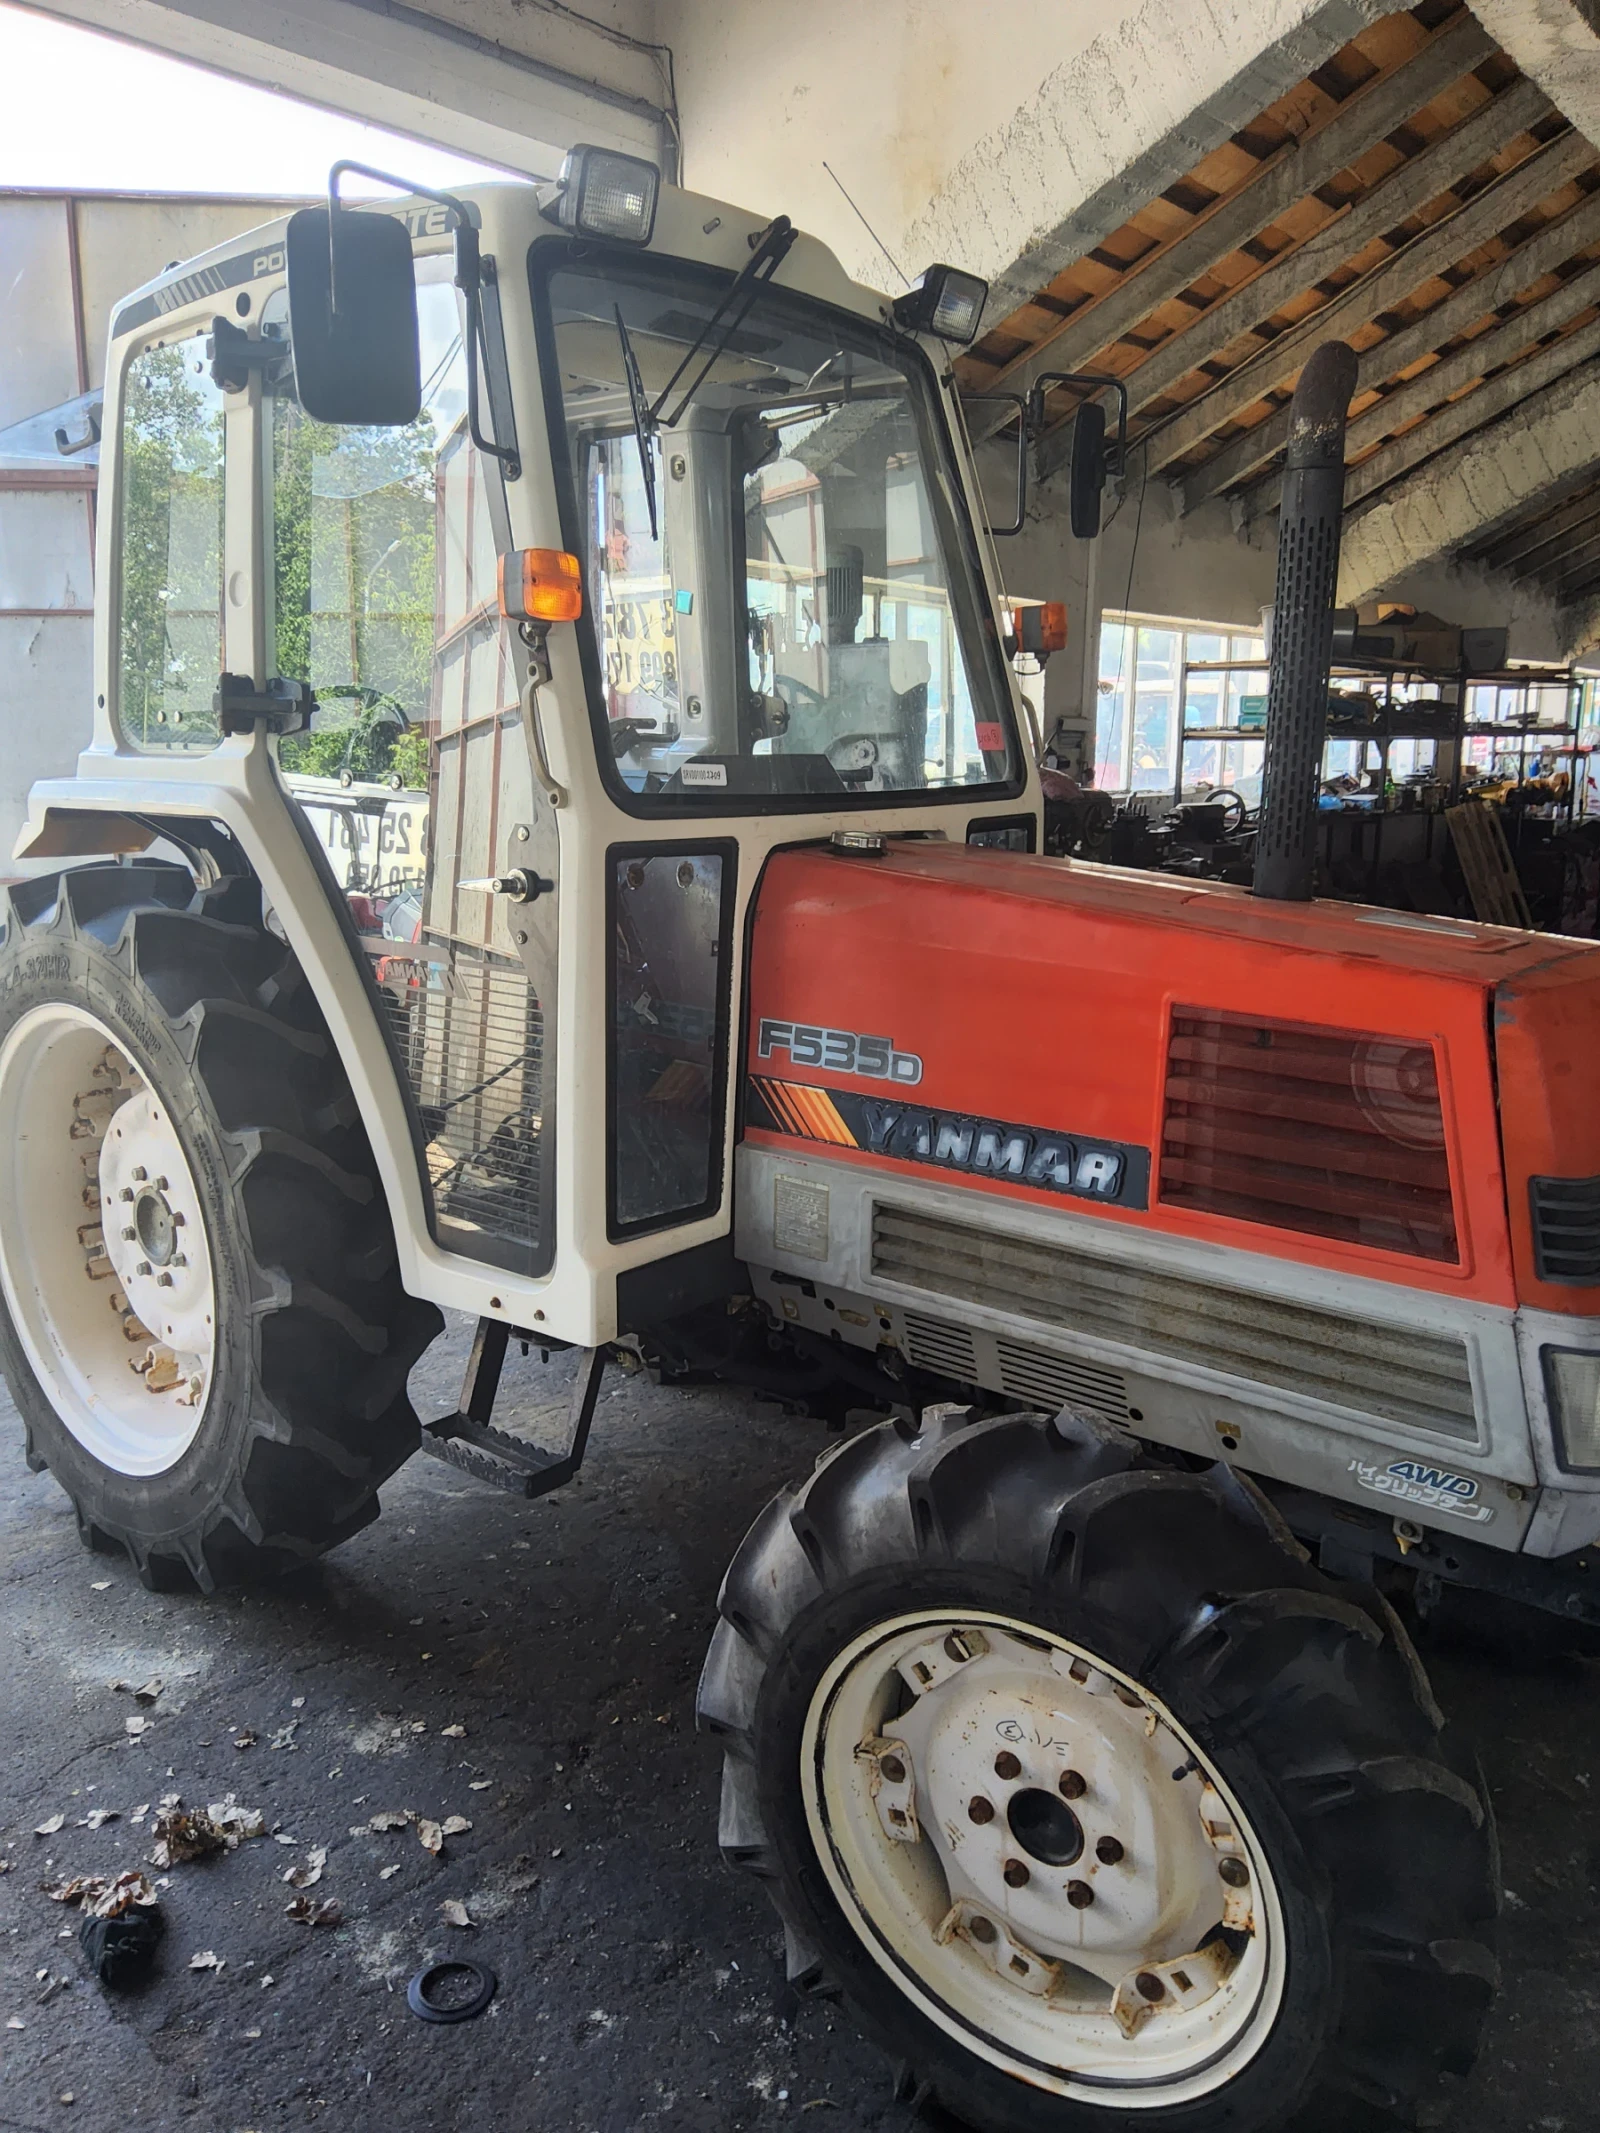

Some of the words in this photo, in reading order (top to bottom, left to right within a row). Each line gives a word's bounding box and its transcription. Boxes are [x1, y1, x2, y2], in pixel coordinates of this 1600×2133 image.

[758, 1018, 923, 1085] F535D
[863, 1104, 1125, 1196] YANMAR
[1387, 1461, 1478, 1499] 4WD
